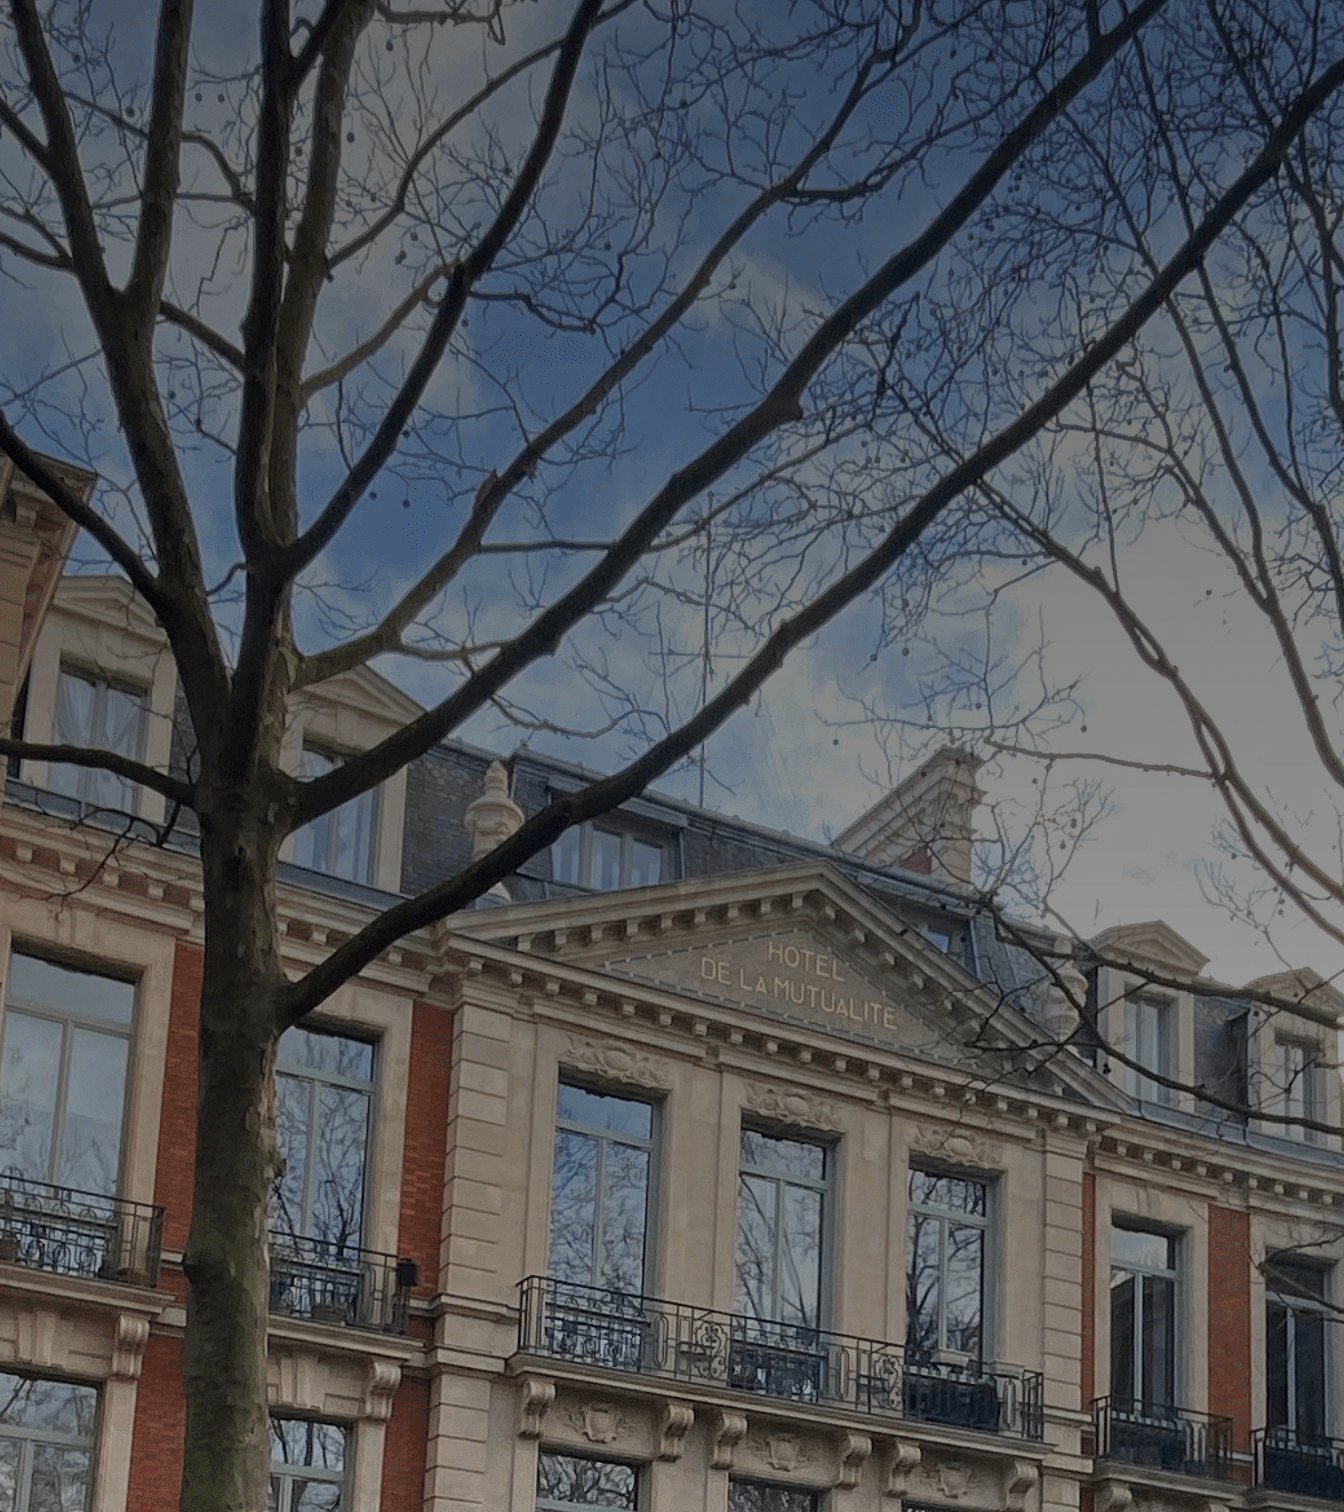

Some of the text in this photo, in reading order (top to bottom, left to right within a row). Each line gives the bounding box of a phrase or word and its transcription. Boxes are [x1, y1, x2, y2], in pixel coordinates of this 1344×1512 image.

[768, 940, 847, 982] HOTEL
[700, 956, 898, 1030] DE LA MUTUALITE
